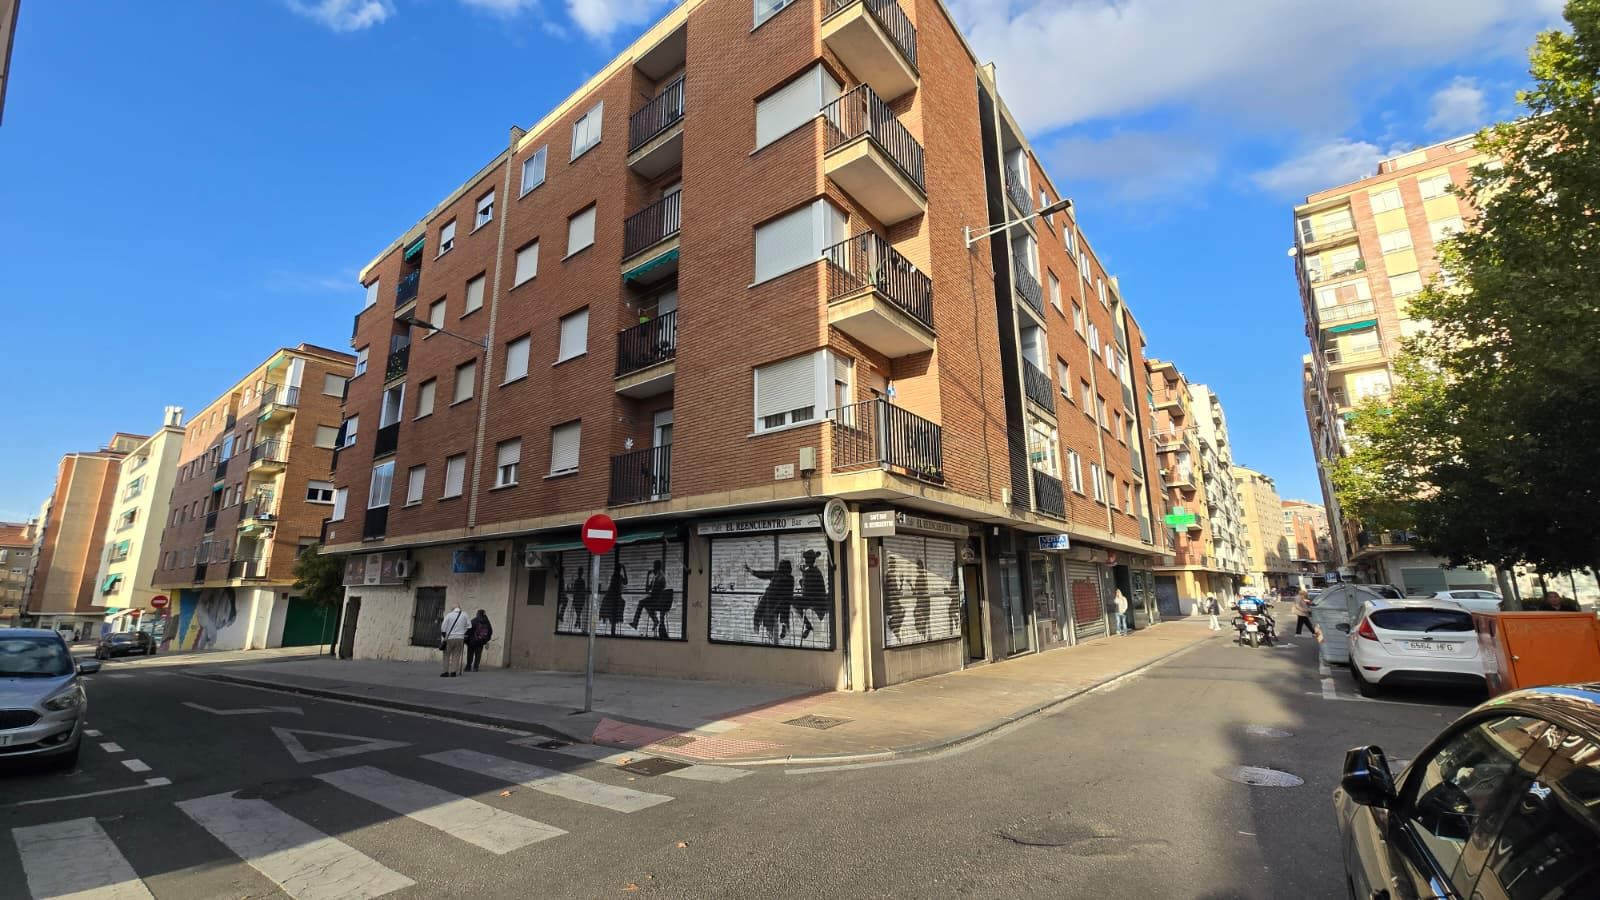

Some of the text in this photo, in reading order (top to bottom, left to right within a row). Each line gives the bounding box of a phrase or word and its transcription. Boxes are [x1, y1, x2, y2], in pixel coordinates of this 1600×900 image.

[726, 522, 734, 531] EL
[736, 518, 787, 531] REENCUENTRO
[791, 518, 802, 527] Bar
